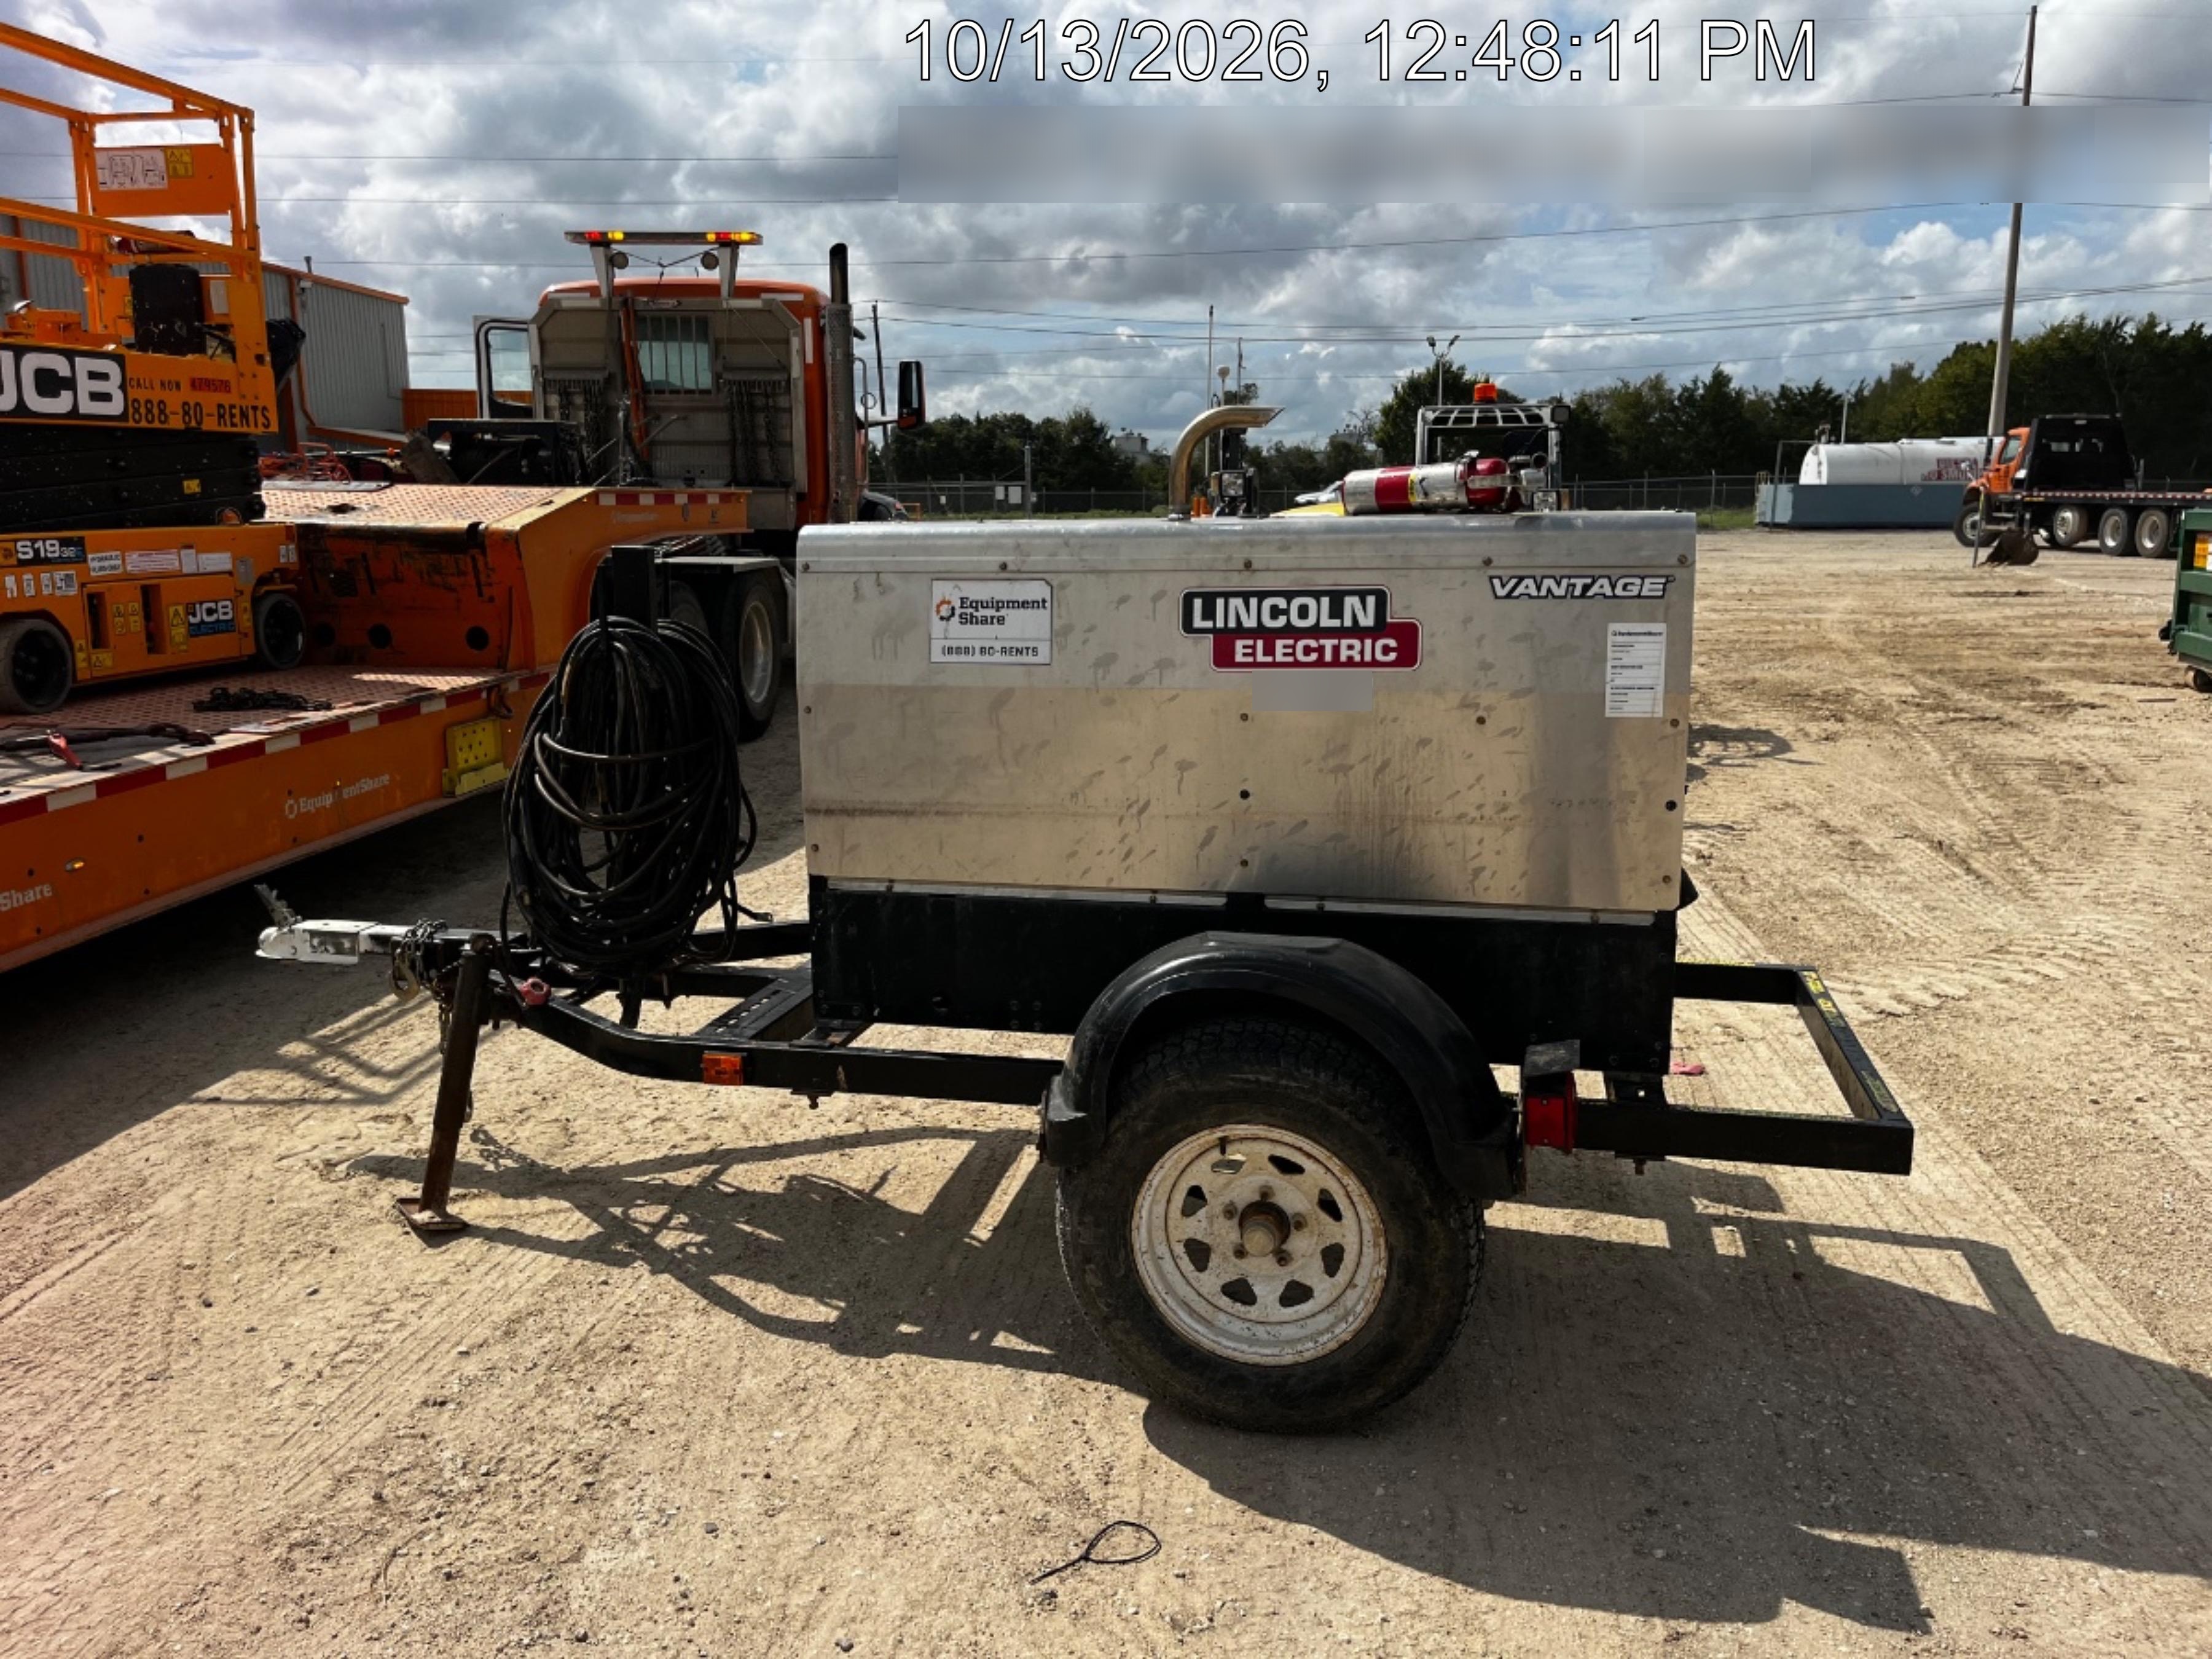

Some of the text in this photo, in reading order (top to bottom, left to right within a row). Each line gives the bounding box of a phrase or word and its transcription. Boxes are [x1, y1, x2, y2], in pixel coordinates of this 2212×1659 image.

[0, 350, 124, 415] JCB
[128, 377, 154, 390] CALL
[160, 379, 181, 391] NOW
[131, 398, 272, 429] 888-80-RENTS
[1488, 575, 1669, 600] VANTAGE
[188, 600, 233, 624] JCB
[959, 596, 1048, 613] Equipment
[1192, 595, 1376, 629] LINCOLN
[959, 611, 1006, 626] Share
[1234, 638, 1398, 663] ELECTRIC
[299, 773, 390, 814] EquipentShare
